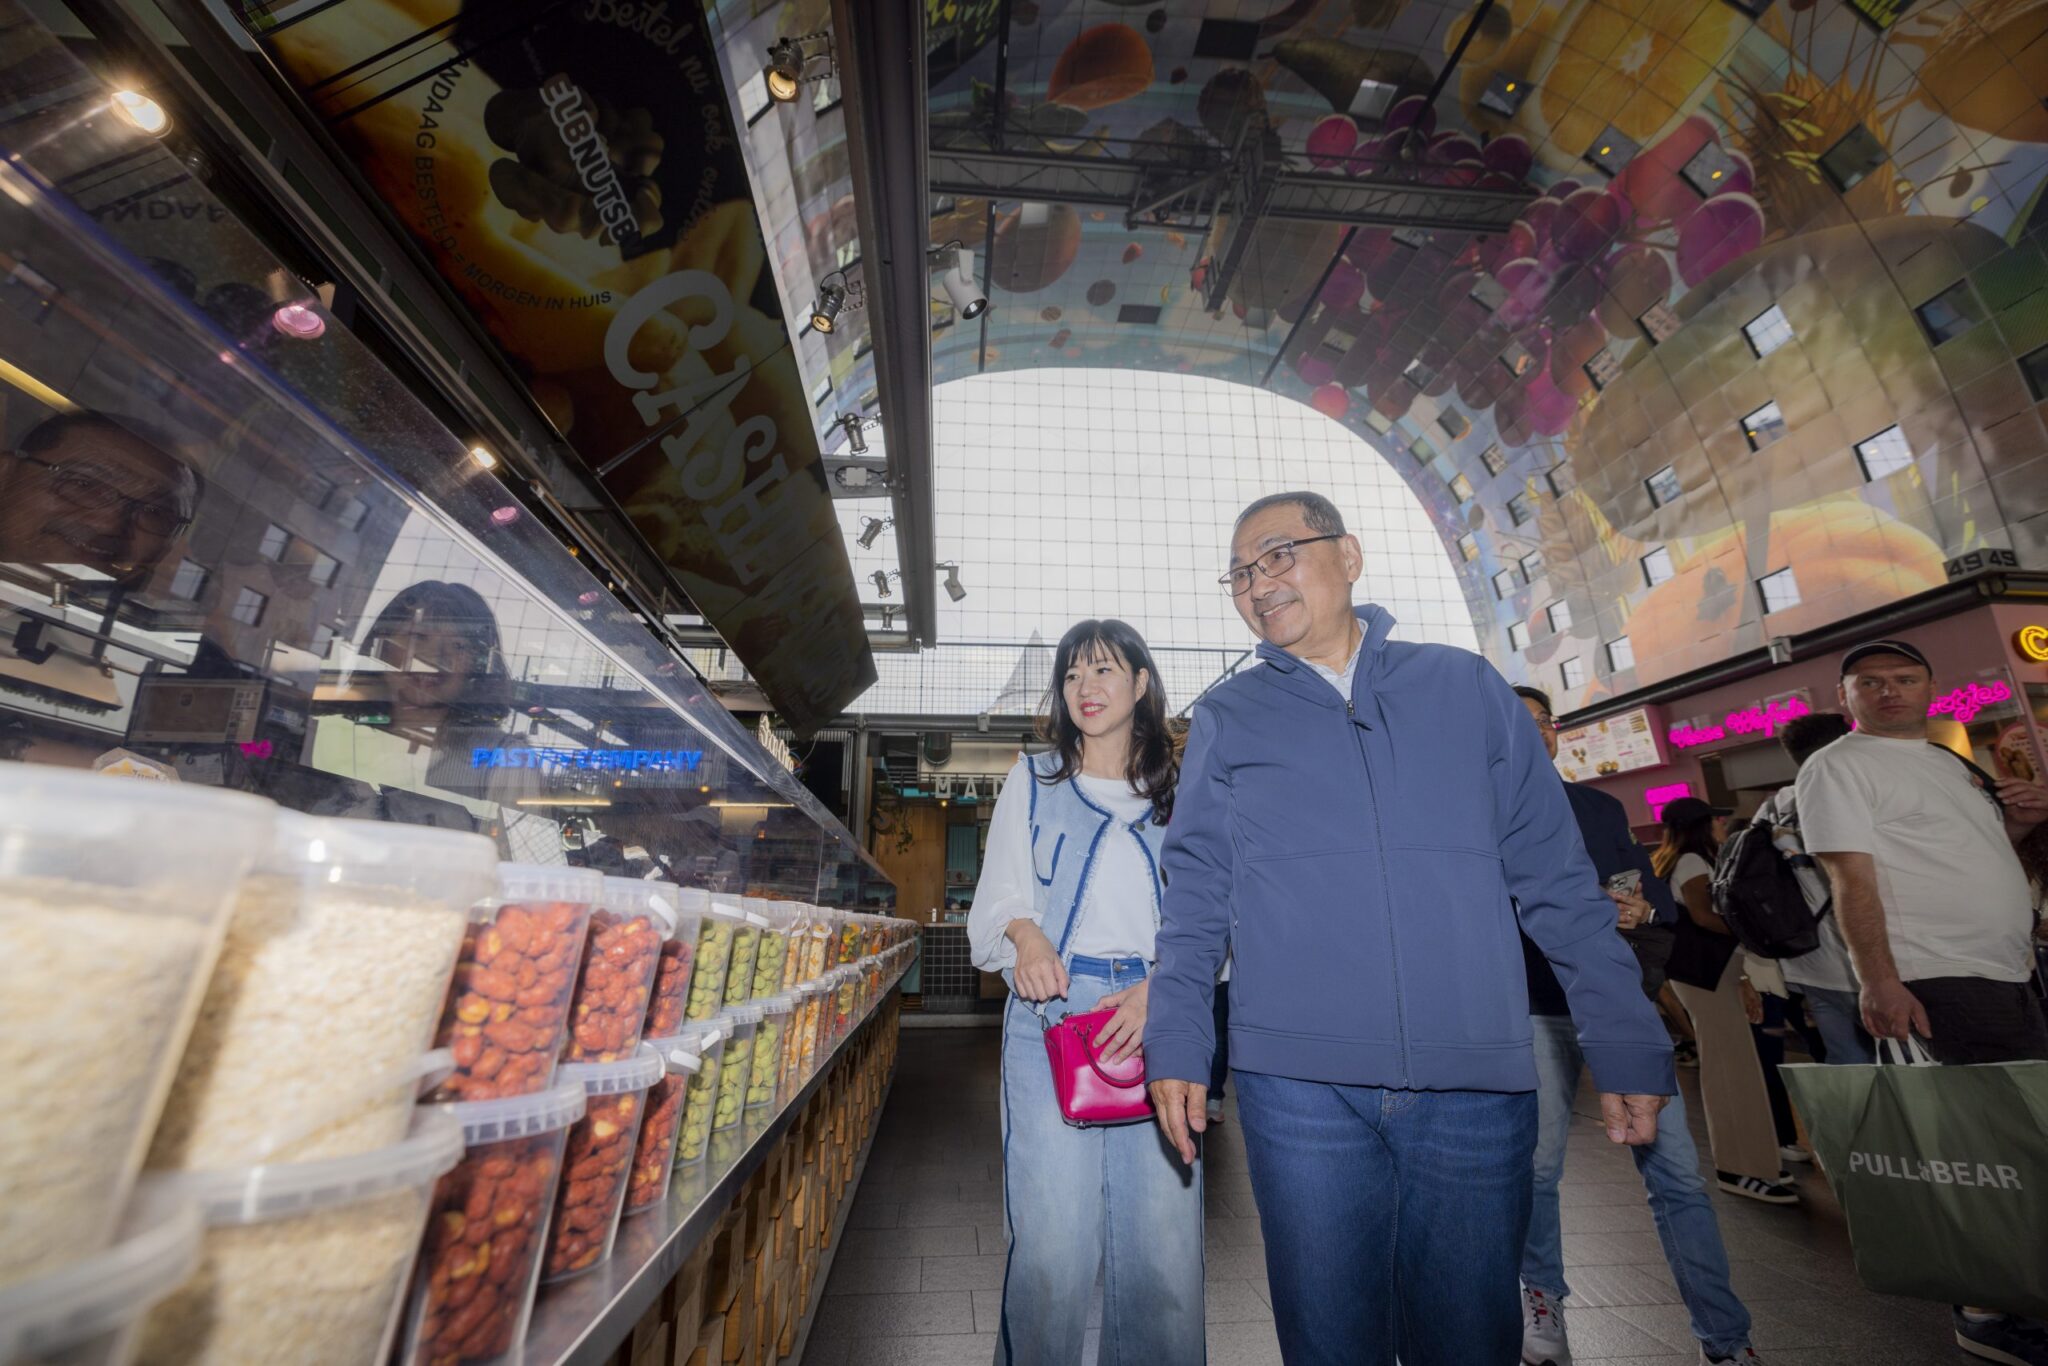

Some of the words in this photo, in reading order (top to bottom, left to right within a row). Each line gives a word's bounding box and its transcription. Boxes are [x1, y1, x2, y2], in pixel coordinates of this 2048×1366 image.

[414, 46, 471, 150] ANDAAG
[679, 54, 711, 95] nu
[701, 103, 738, 154] ook
[415, 157, 457, 251] BESTELD
[464, 262, 539, 308] MORGEN
[545, 293, 565, 311] IN
[570, 290, 612, 309] HUIS
[1949, 553, 1984, 577] 49
[1989, 550, 2019, 567] 49
[1848, 1151, 2024, 1191] PULL&BEAR
